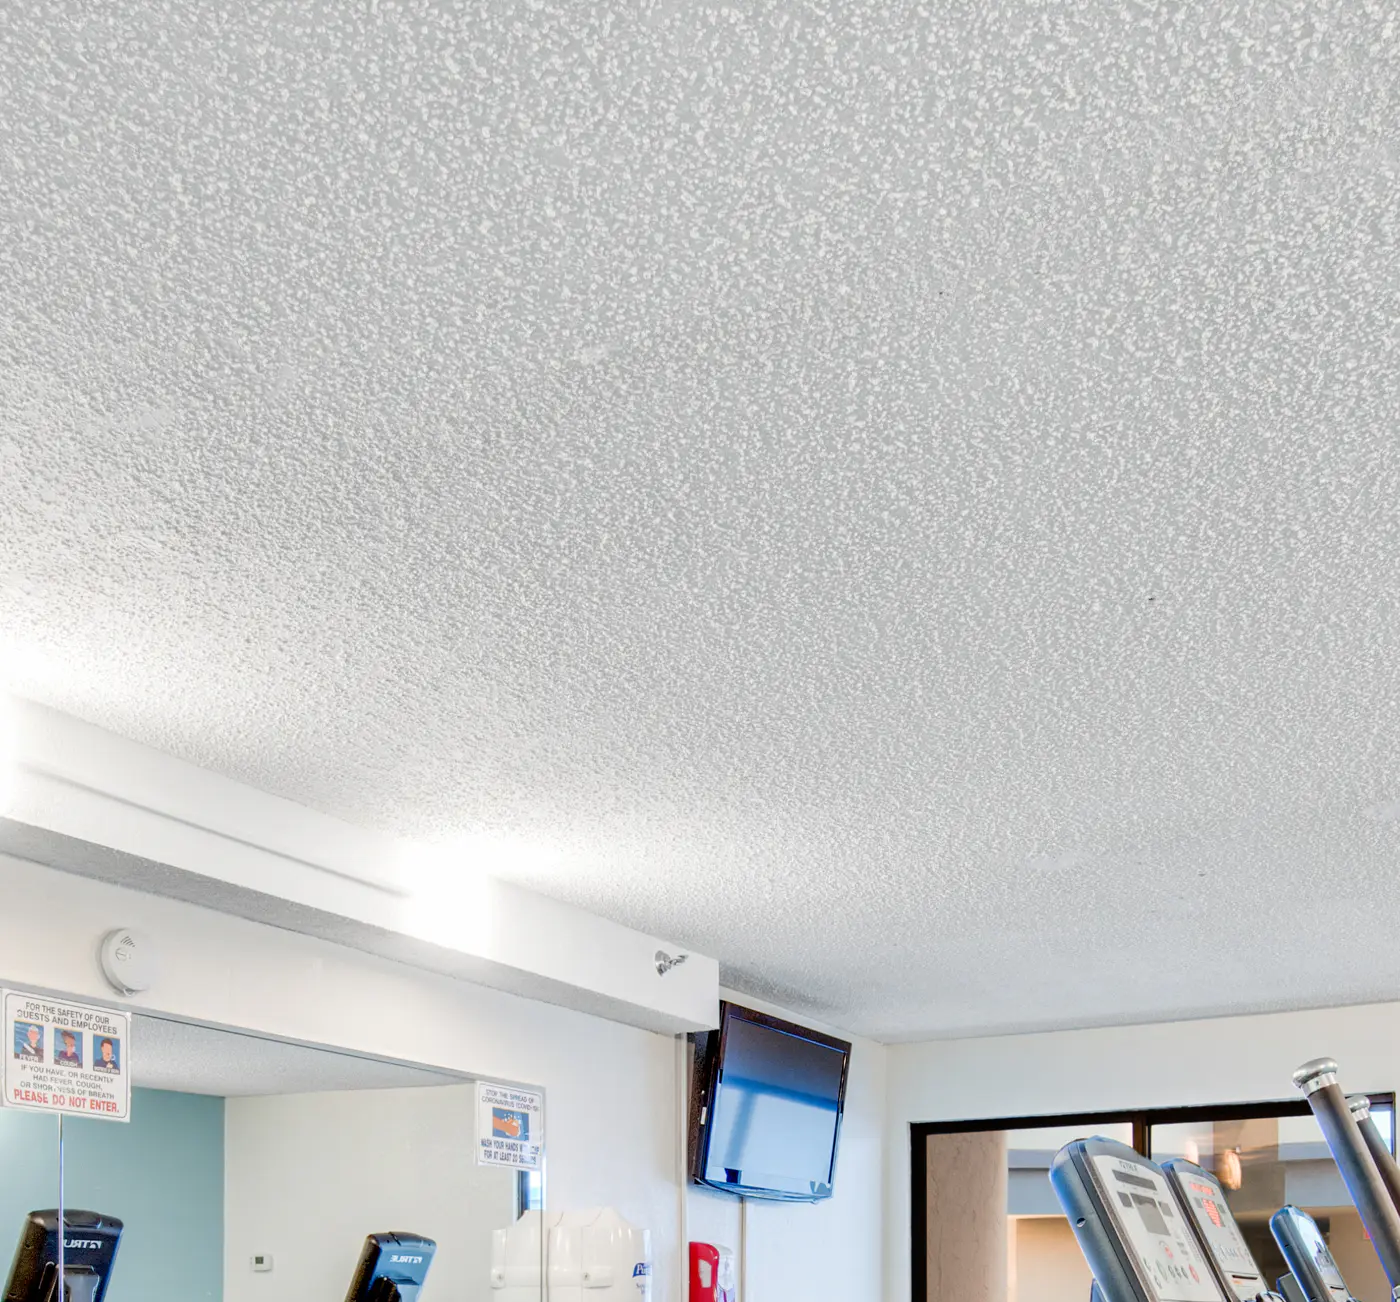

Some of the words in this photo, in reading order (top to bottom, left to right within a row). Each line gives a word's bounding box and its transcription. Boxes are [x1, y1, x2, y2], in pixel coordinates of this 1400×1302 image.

[25, 1001, 40, 1012] FOR
[42, 1005, 56, 1015] THE
[57, 1007, 82, 1019] SAFETY
[84, 1013, 93, 1021] OF
[95, 1015, 110, 1025] OUR
[52, 1016, 69, 1026] AND
[71, 1019, 118, 1035] EMPLOYEES
[29, 1065, 44, 1074] YOU
[68, 1071, 78, 1079] OR
[80, 1073, 114, 1084] RECENTLY
[33, 1074, 48, 1082] HAD
[76, 1080, 103, 1091] COUGH,
[20, 1081, 30, 1089] OR
[77, 1088, 86, 1096] OF
[88, 1090, 115, 1100] BREATH
[14, 1089, 49, 1104] PLEASE
[52, 1094, 65, 1105] DO
[69, 1096, 87, 1109] NOT
[90, 1100, 120, 1113] ENTER.
[484, 1149, 493, 1160] FOR
[494, 1151, 499, 1160] AT
[500, 1152, 512, 1162] LEAST
[494, 1140, 504, 1150] YOUR
[505, 1142, 519, 1152] HANDS
